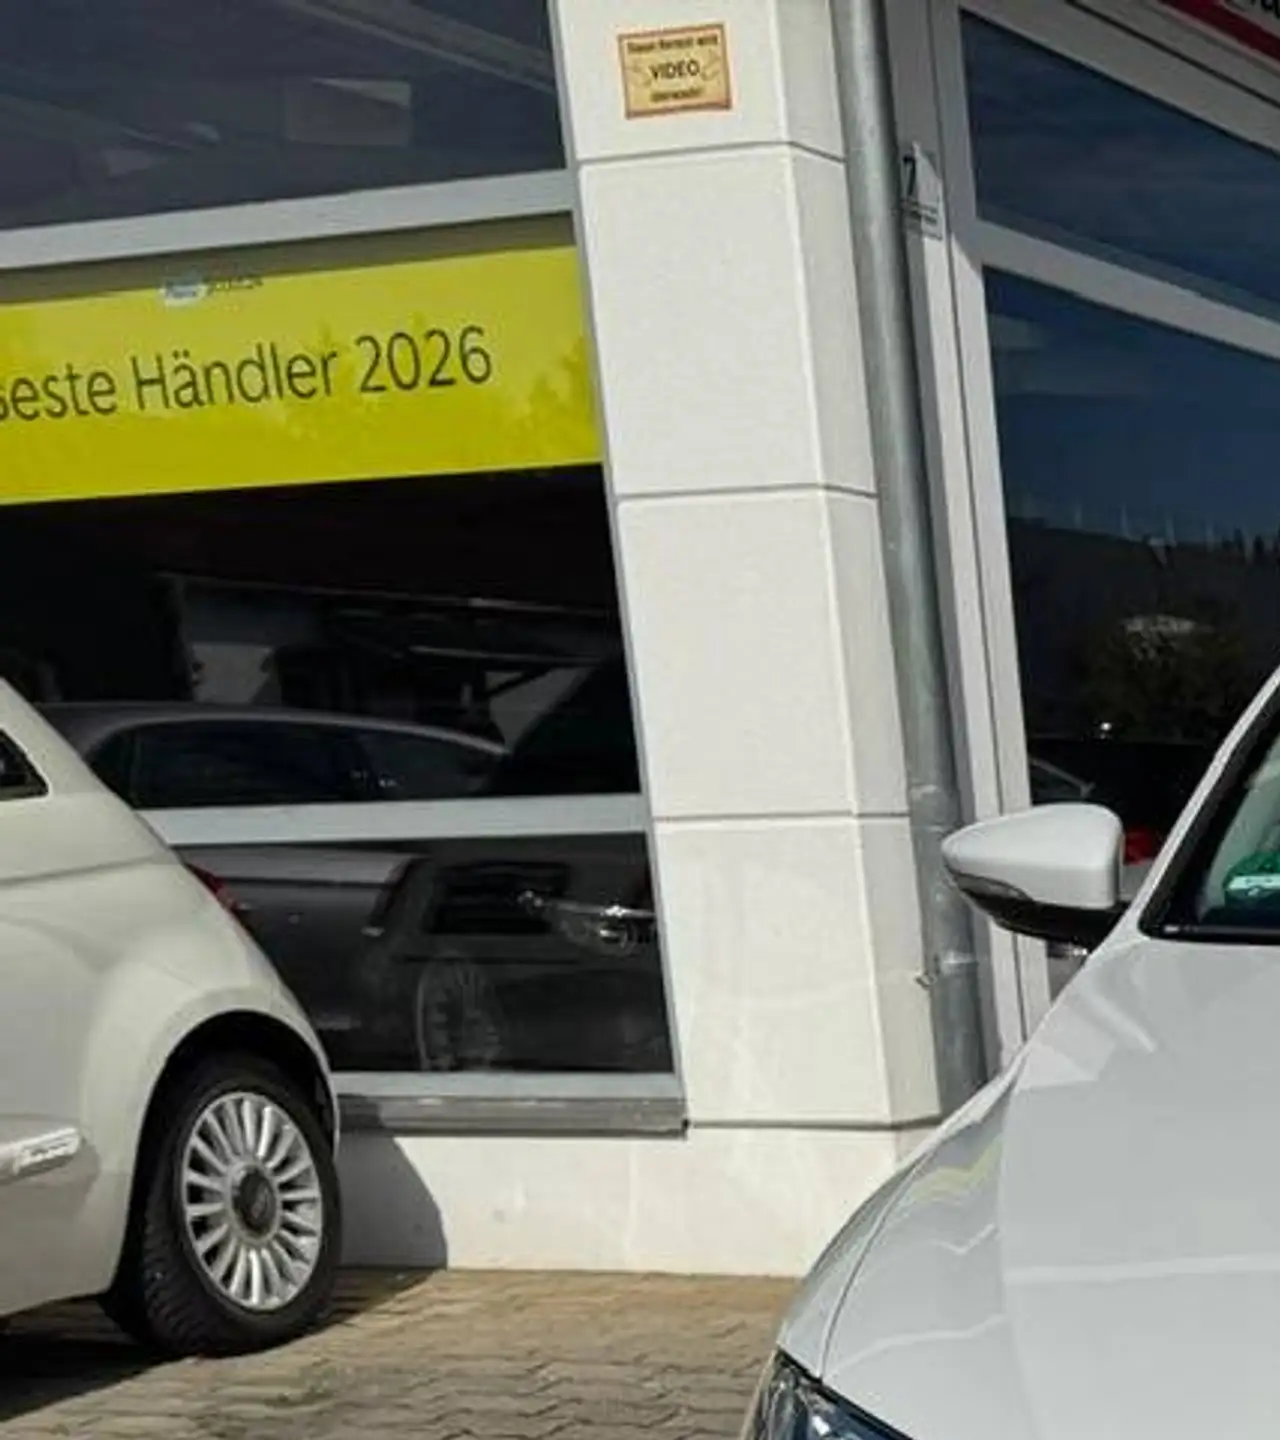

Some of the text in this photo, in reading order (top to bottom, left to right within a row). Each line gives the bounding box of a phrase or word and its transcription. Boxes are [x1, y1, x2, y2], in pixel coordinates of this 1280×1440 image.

[648, 58, 700, 81] VIDEO
[132, 342, 338, 410] Händler
[355, 325, 492, 394] 2026
